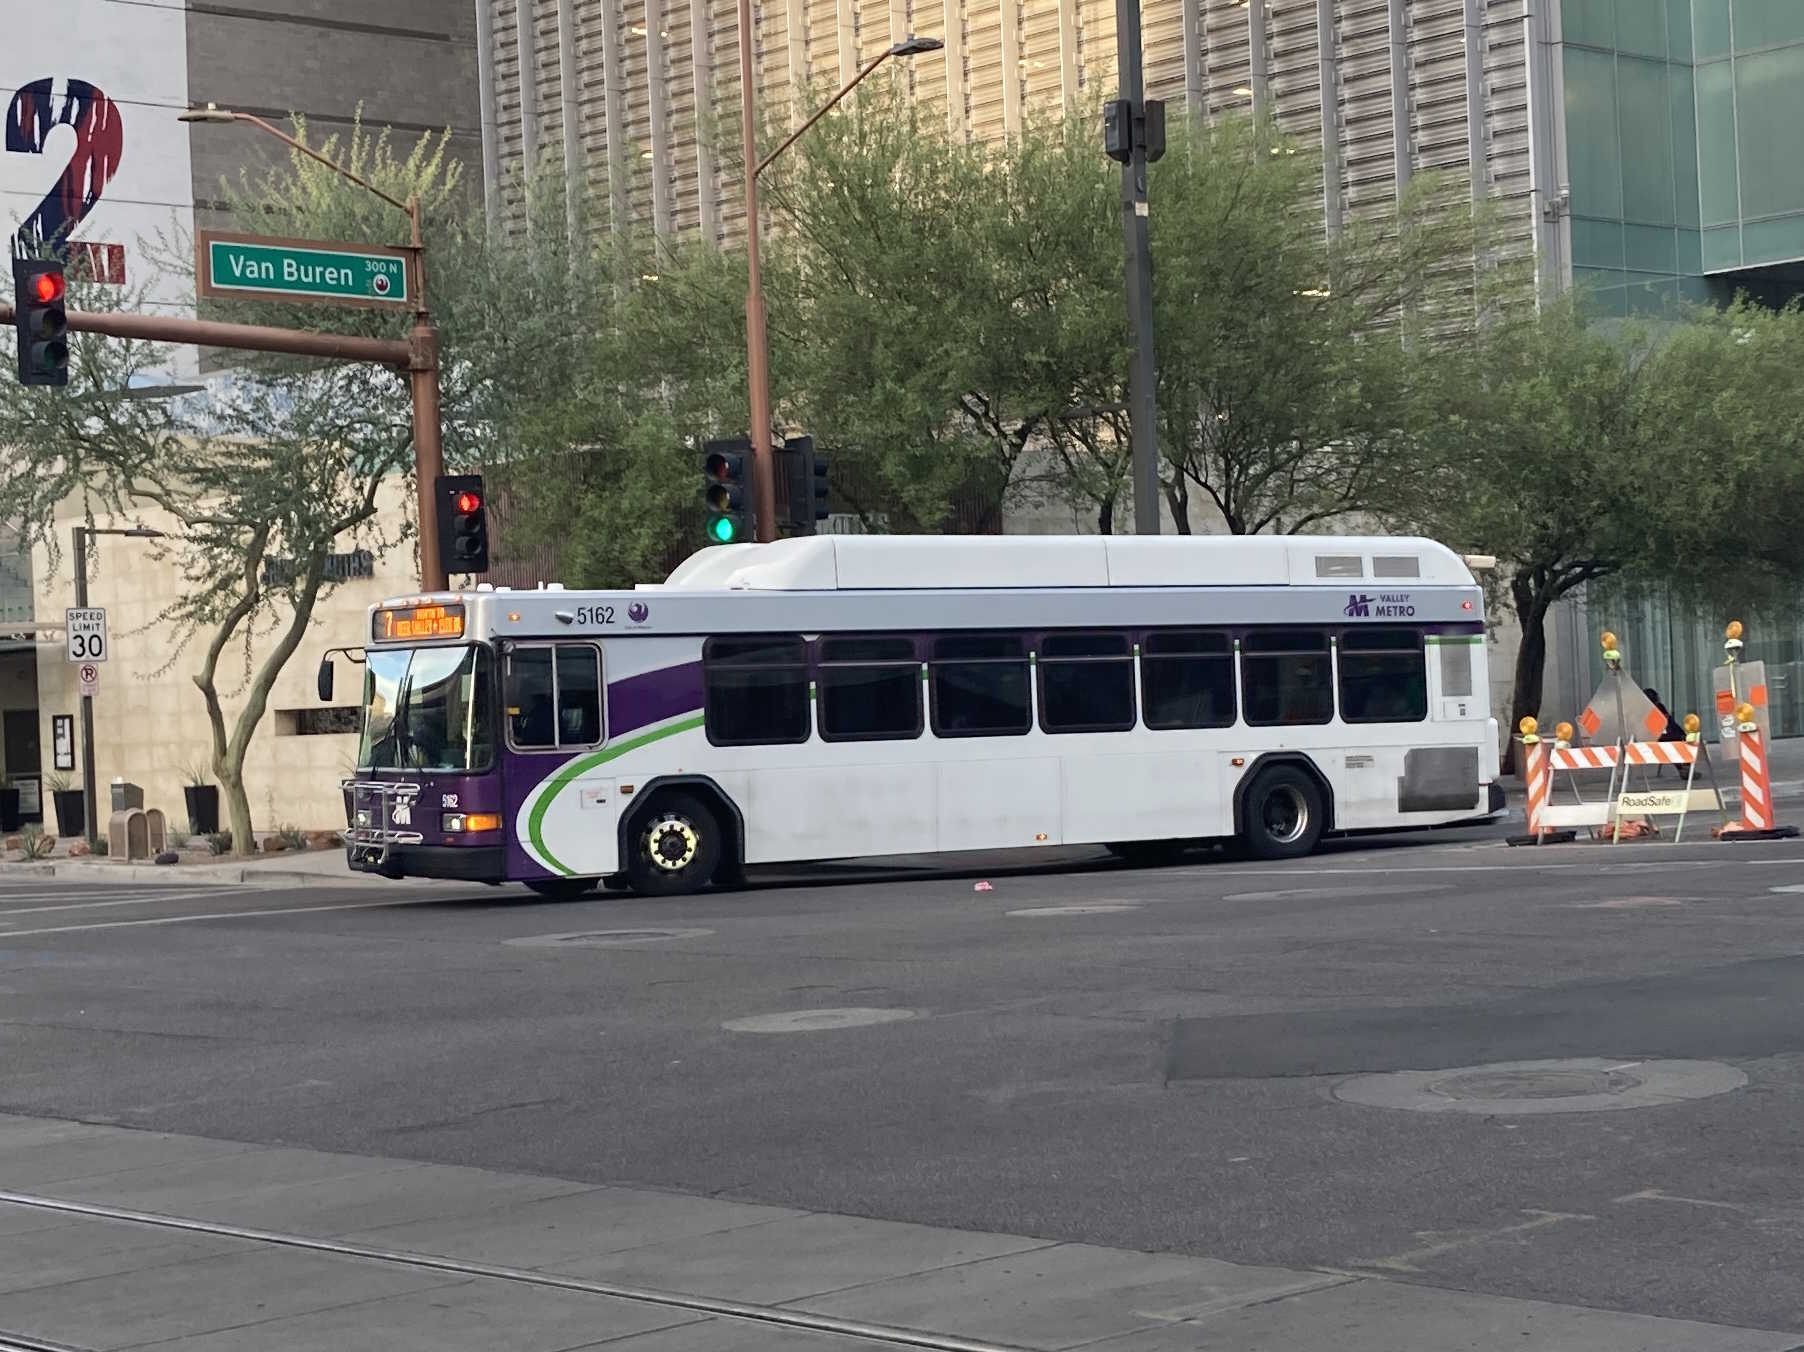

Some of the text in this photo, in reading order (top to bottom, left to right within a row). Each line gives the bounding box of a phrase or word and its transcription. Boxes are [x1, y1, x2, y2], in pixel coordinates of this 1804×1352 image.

[229, 254, 353, 286] Van Buren
[364, 260, 398, 275] 300 N
[1380, 594, 1410, 603] VALLEY
[69, 612, 103, 621] SPEED
[577, 606, 615, 625] 5162
[1375, 605, 1415, 617] METRO
[72, 622, 100, 632] LIMIT
[72, 634, 103, 658] 30
[1622, 795, 1672, 808] RoadSafe
